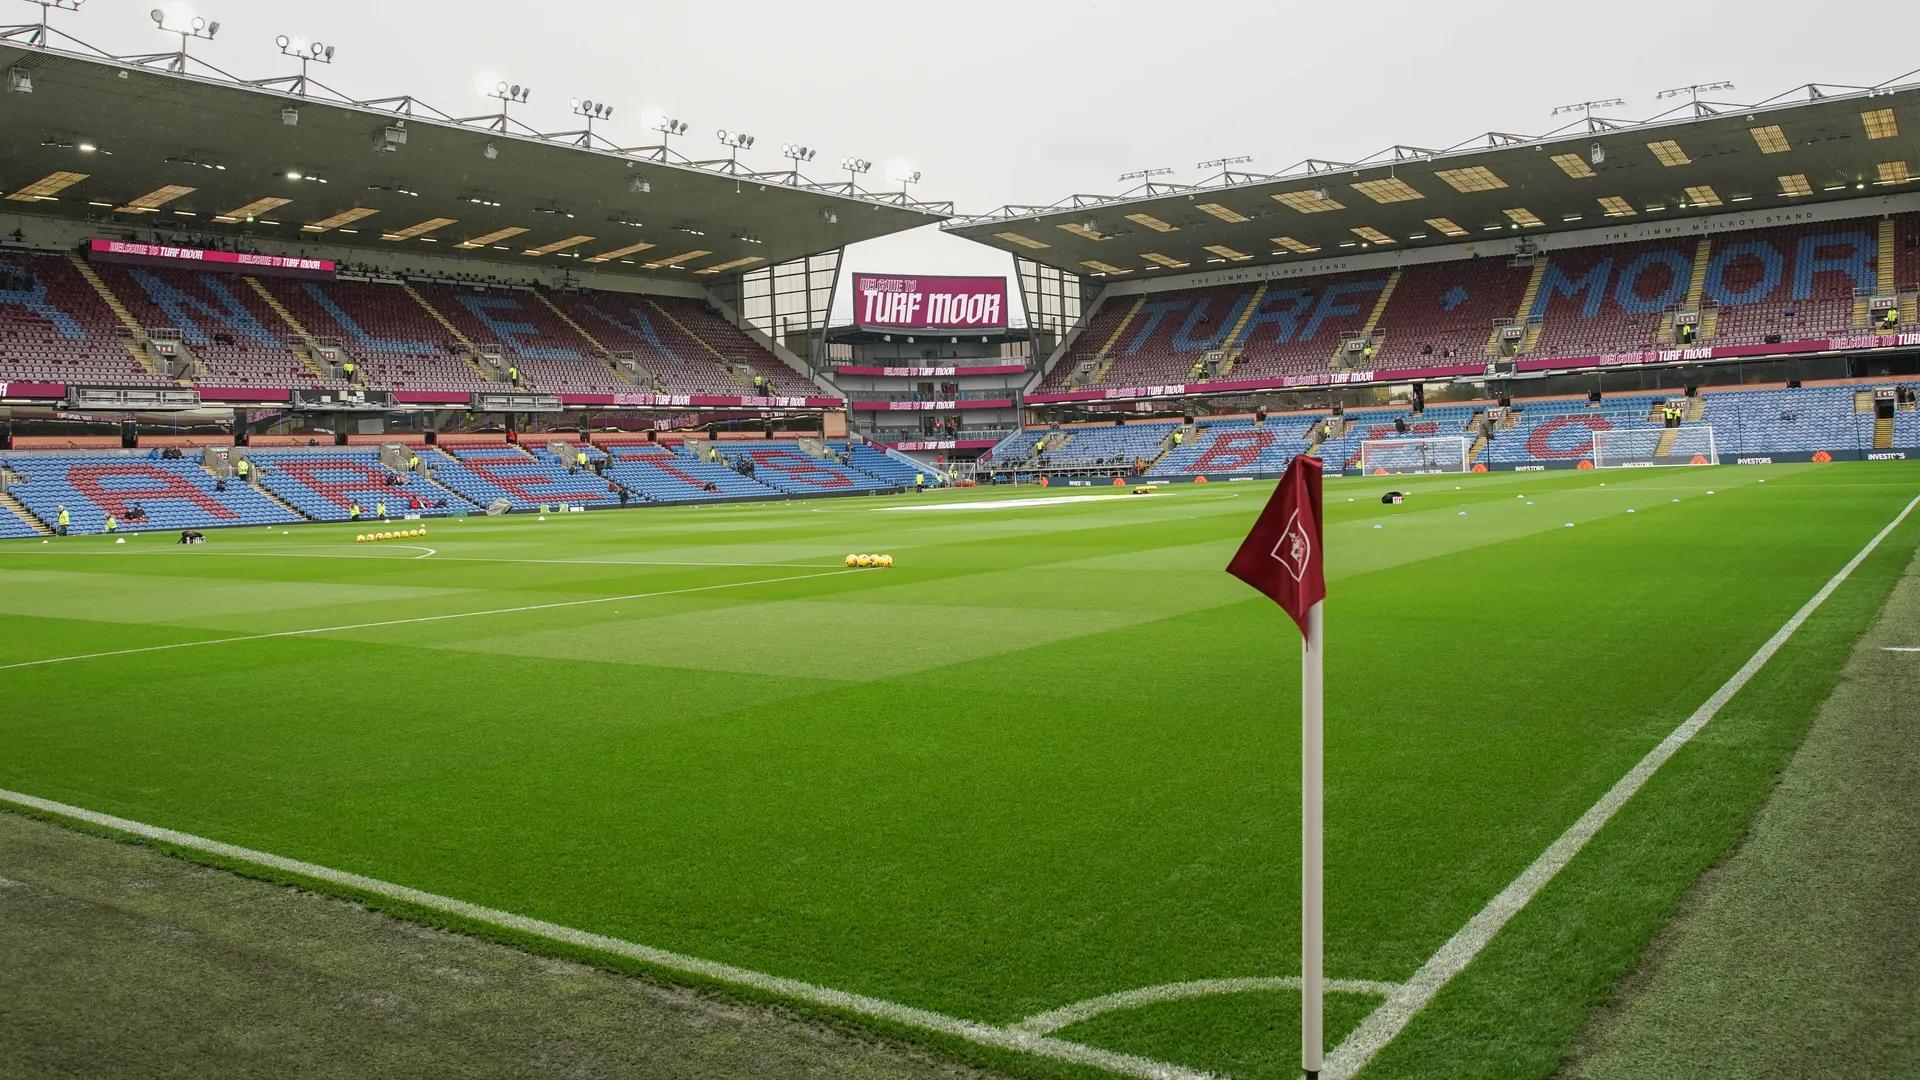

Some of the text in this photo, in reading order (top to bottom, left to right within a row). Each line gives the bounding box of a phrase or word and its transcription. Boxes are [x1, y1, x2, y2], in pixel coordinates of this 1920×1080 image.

[1605, 232, 1628, 240] THE
[1639, 226, 1682, 237] JIMMY
[1766, 212, 1813, 223] STAND
[160, 246, 180, 258] TURF
[181, 248, 203, 259] MOOR
[282, 257, 300, 268] TURF
[300, 259, 320, 269] MOOR
[1216, 274, 1249, 282] JIMMY
[1311, 262, 1347, 272] STAND
[1528, 230, 1880, 320] MOOR
[859, 278, 917, 292] WELCOME TO
[864, 290, 1001, 324] TURF MOOR
[1123, 277, 1388, 358] TURF
[1828, 334, 1920, 350] WELCOME TO TUR
[1600, 347, 1713, 365] WELCOME TO TURF MOOR
[918, 367, 934, 376] TURF
[935, 367, 956, 375] MOOR
[1330, 373, 1350, 383] TURF
[1350, 371, 1374, 382] MOOR
[1146, 386, 1164, 396] TURF
[1165, 385, 1185, 394] MOOR
[655, 395, 671, 405] TURF
[672, 395, 690, 405] MOOR
[775, 397, 790, 406] TURF
[790, 397, 806, 406] MOOR
[920, 401, 935, 410] TURF
[935, 401, 955, 409] MOOR
